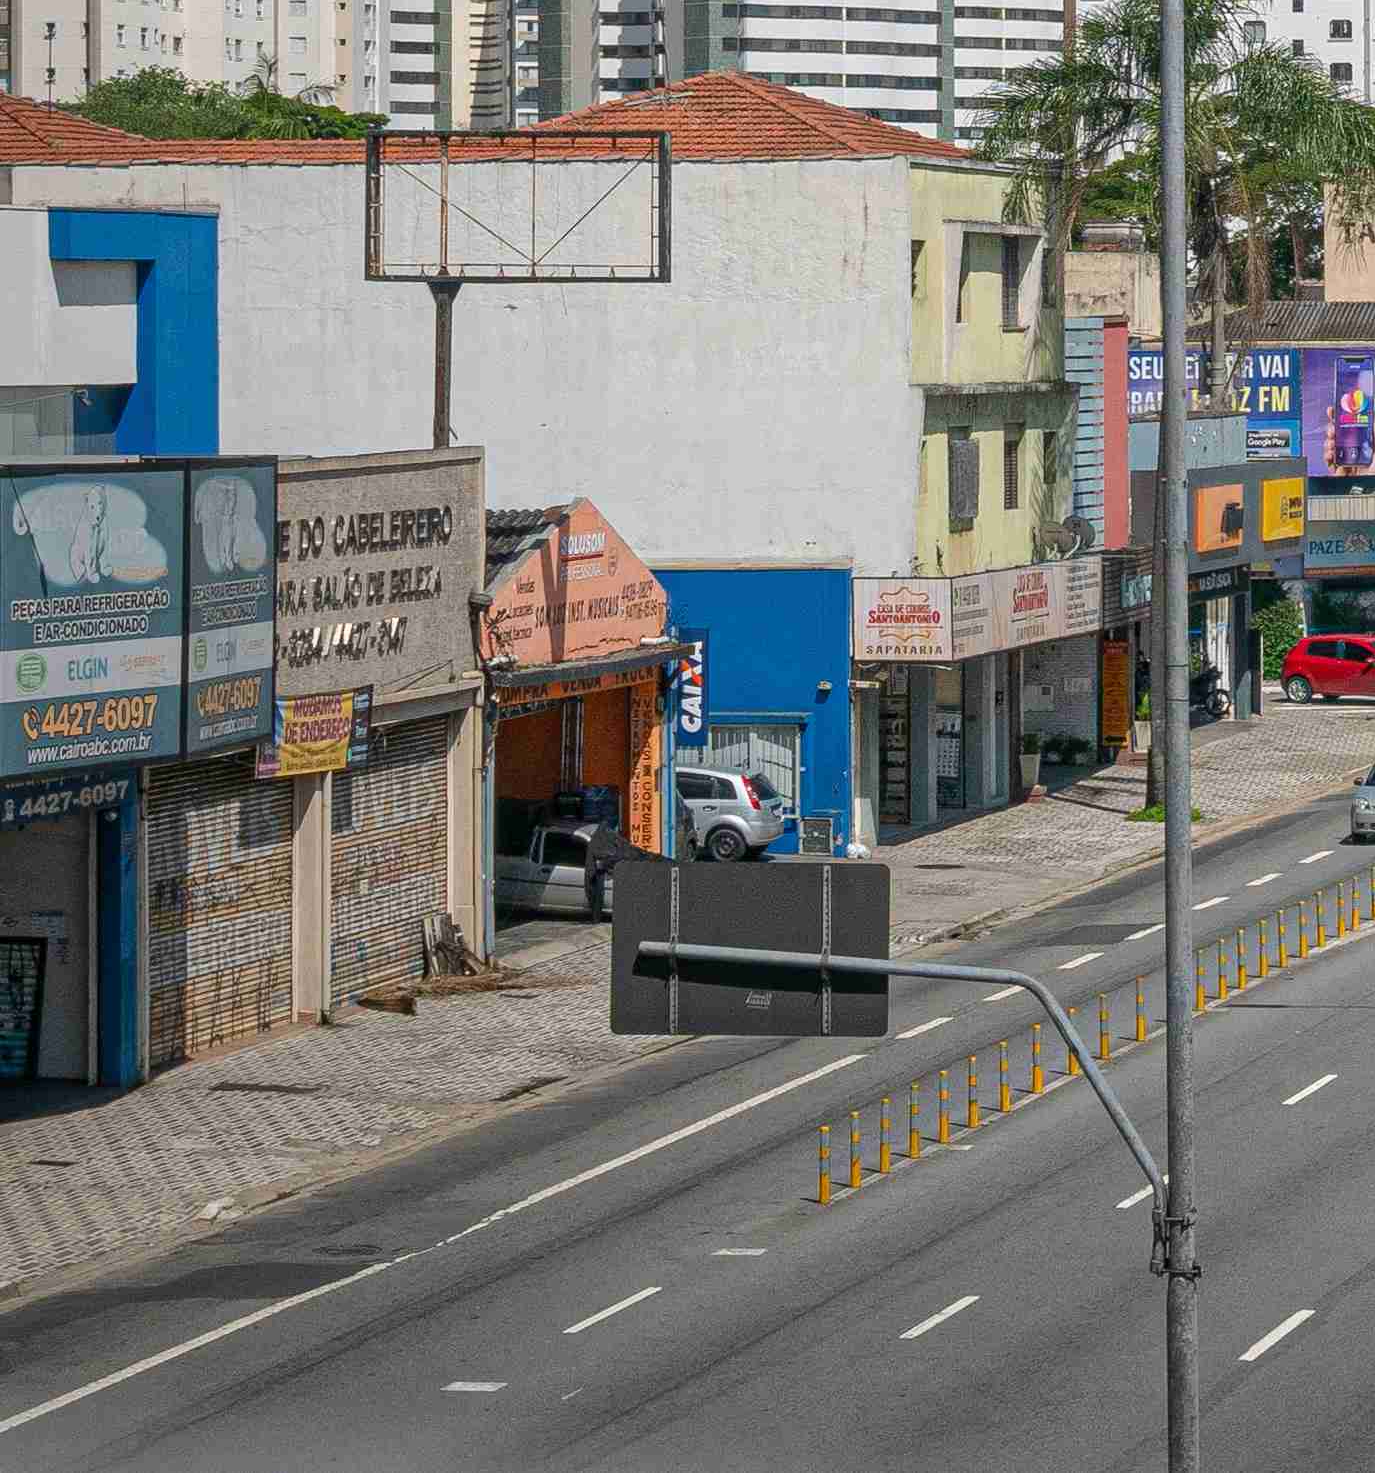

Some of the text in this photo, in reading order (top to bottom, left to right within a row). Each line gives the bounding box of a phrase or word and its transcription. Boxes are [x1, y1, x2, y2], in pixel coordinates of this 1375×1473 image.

[1259, 355, 1291, 378] VAI
[1258, 385, 1291, 412] FM
[1247, 436, 1286, 447] Google Play
[12, 600, 50, 622] PEÇAS
[52, 596, 82, 616] PARA
[84, 588, 169, 614] REFRIGERAÇÃO
[44, 616, 148, 641] AR-CONDICIONADO
[866, 645, 943, 656] SAPATARIA
[68, 656, 109, 681] ELGIN
[680, 640, 703, 734] CAIXA
[41, 694, 158, 737] 4427-6097
[27, 732, 153, 765] www.cairoabc.com.br
[19, 781, 129, 816] 4427-6097
